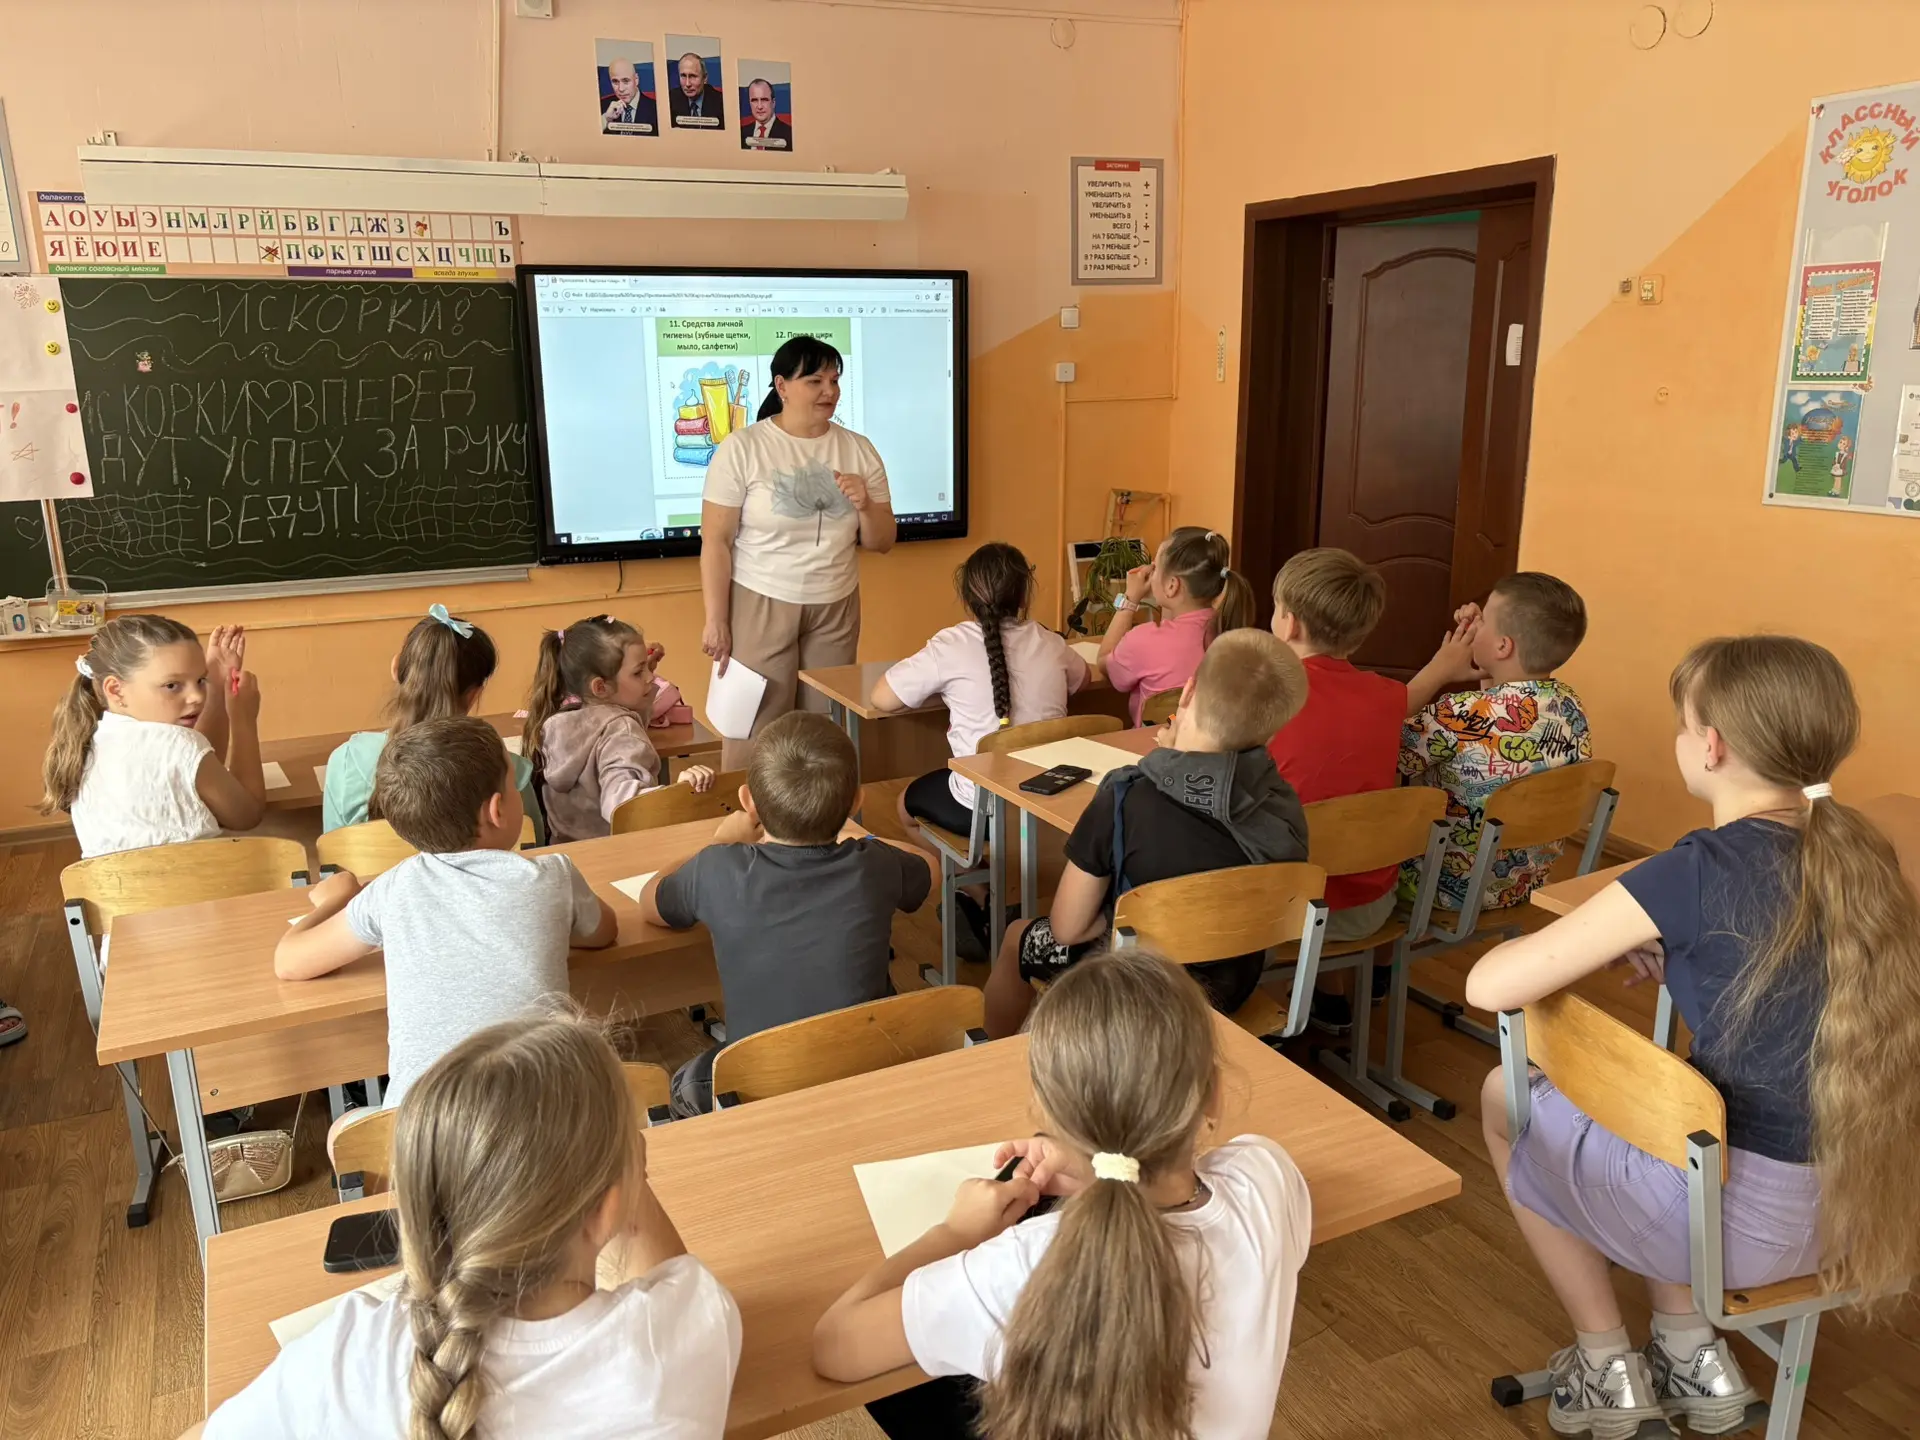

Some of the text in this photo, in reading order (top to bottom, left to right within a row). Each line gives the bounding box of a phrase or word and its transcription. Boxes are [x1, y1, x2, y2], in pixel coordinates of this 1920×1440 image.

[1819, 102, 1920, 164] КЛАССНЫЙ
[1826, 168, 1909, 204] УГОЛОК
[46, 210, 509, 236] А О У Ы Э Н М Л Р Й Б В Г Д Ж З Ъ
[50, 237, 511, 266] Я Ё Ю И Е П Ф К Т Ш С Х Ц Ч Щ Ь
[88, 265, 130, 273] согласный
[325, 268, 377, 276] парные глухие
[669, 319, 744, 329] 11. Средства личной
[695, 331, 724, 341] (зубные
[726, 332, 751, 341] щетки,
[815, 332, 833, 340] цирк
[677, 342, 739, 352] мыло, салфетки)
[200, 436, 350, 489] УСПЕХ
[364, 424, 419, 478] ЗА
[444, 422, 528, 476] РУКУ
[207, 482, 360, 549] ВЕДУТ!
